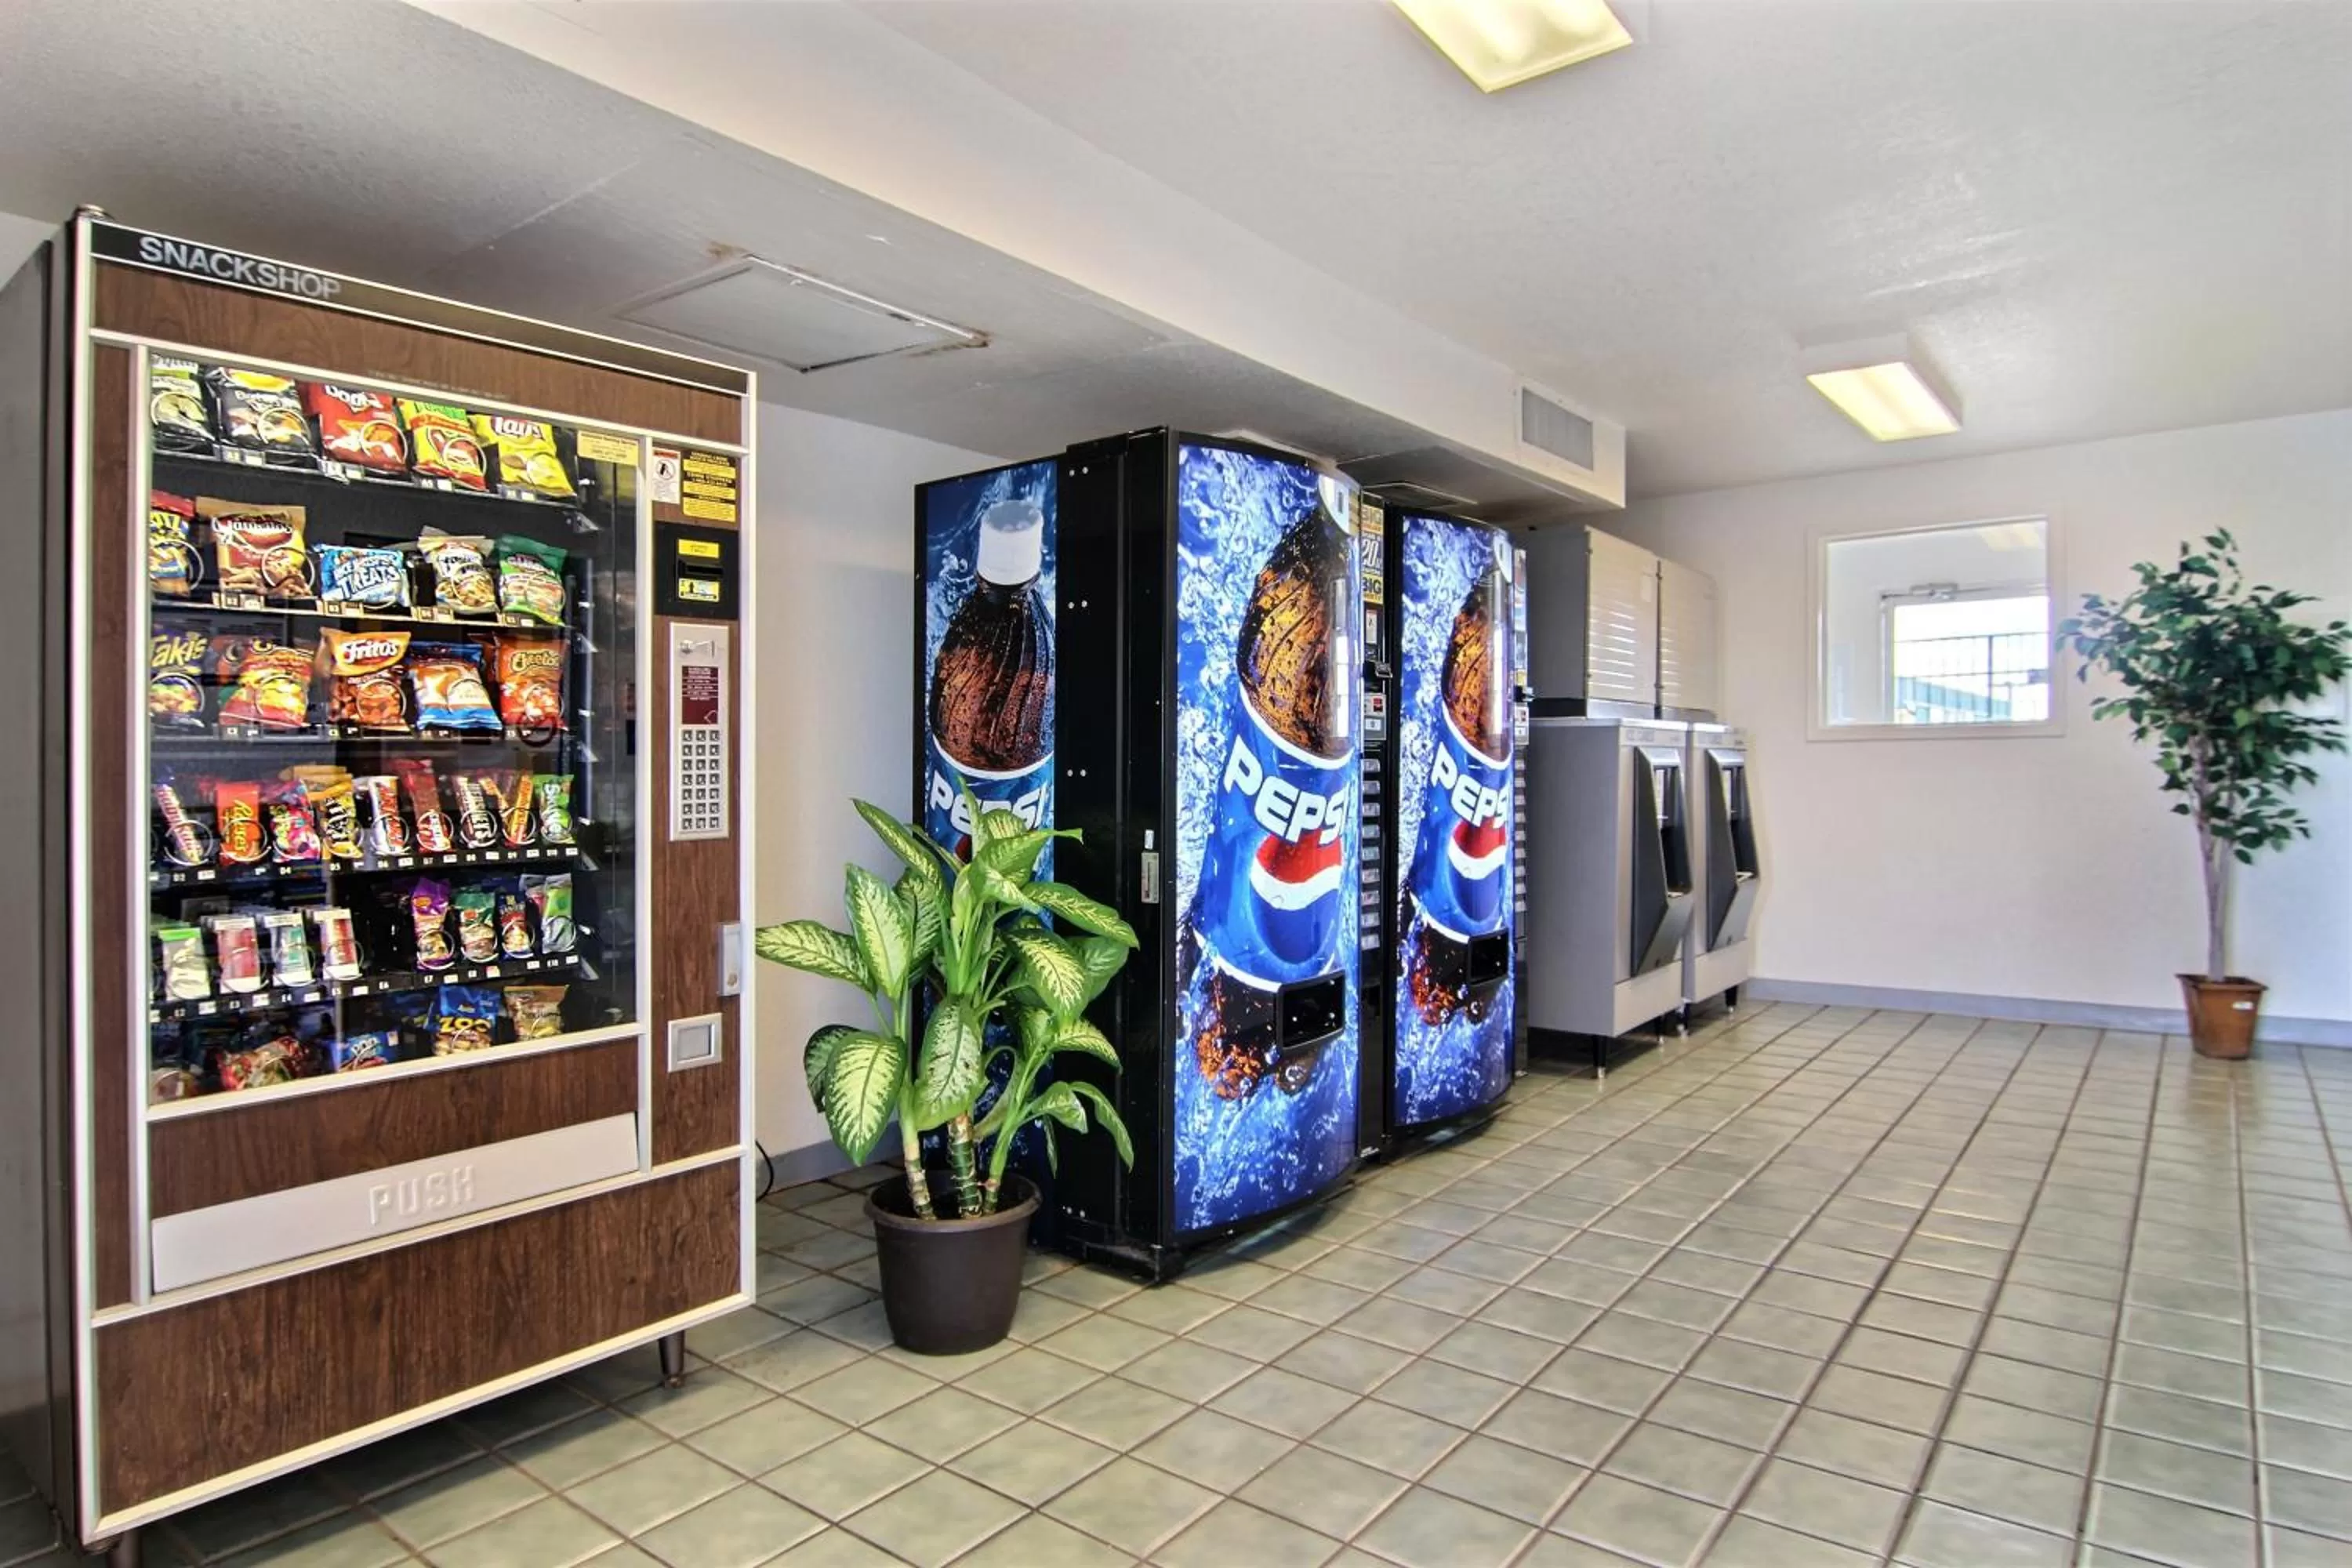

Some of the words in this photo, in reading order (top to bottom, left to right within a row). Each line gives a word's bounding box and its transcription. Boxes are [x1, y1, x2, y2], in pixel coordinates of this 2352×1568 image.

[140, 237, 341, 299] SNACKSHOP
[337, 563, 401, 601] TREATS
[341, 640, 397, 663] Fritos
[369, 1164, 474, 1225] PUSH
